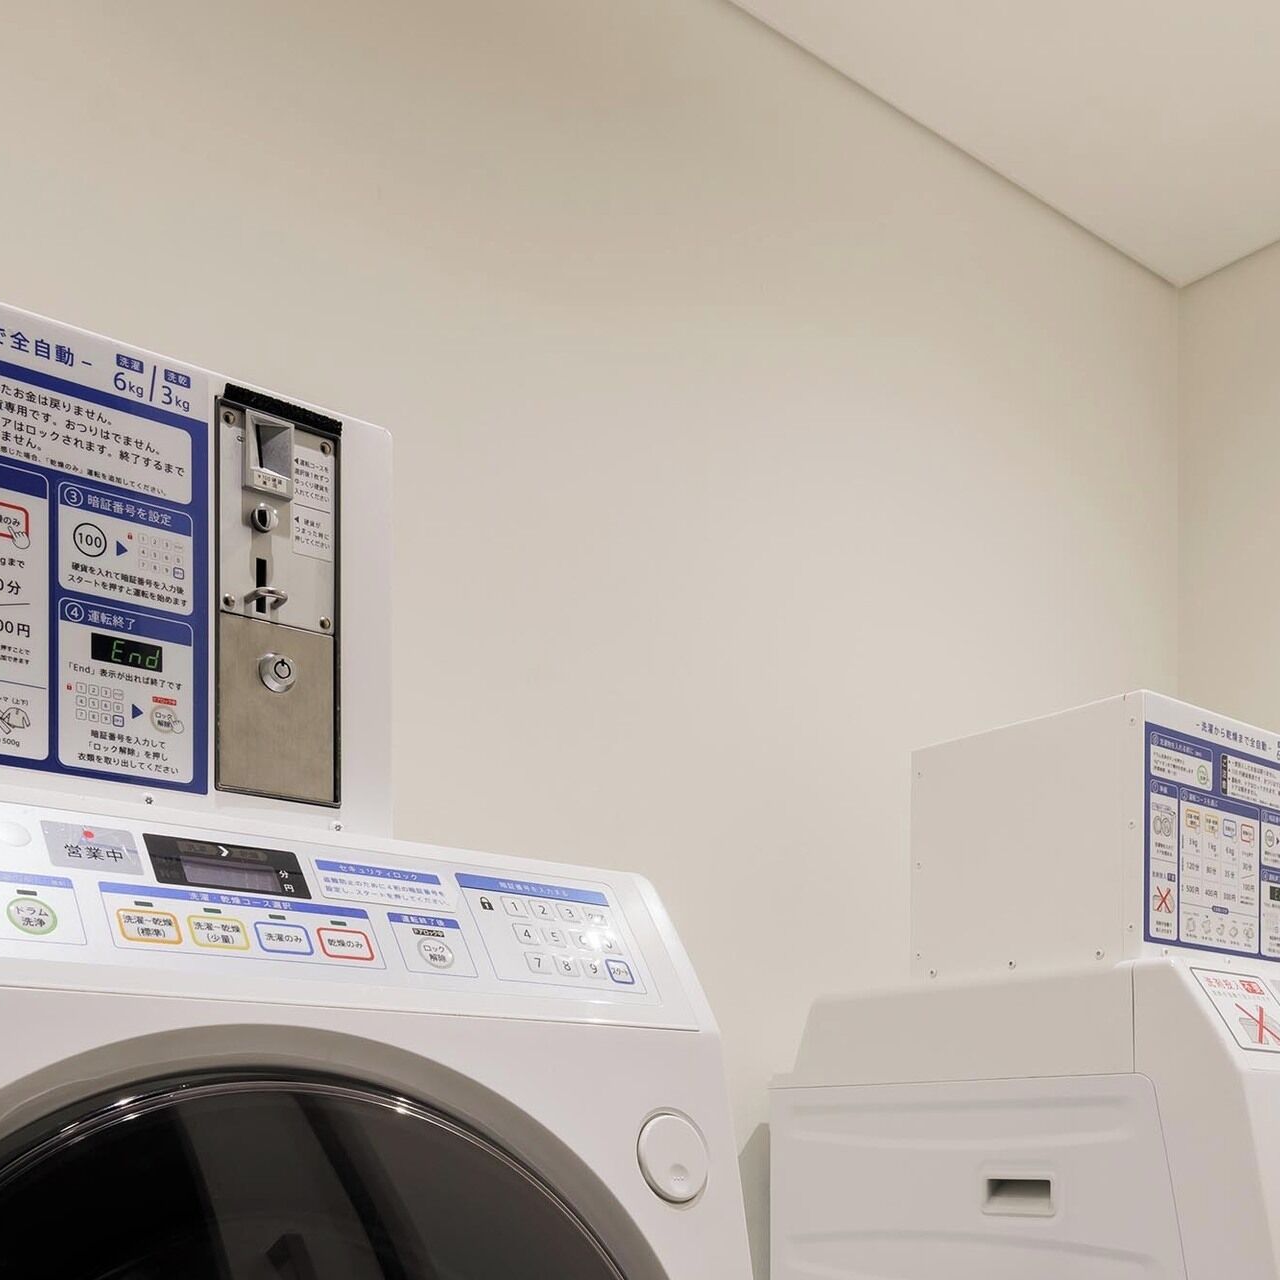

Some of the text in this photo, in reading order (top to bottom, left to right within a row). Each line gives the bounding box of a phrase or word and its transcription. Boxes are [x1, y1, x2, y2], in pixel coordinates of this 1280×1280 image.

[119, 357, 142, 372] 洗濯
[87, 494, 172, 527] 暗証番号を設定
[77, 531, 101, 549] 100
[71, 561, 185, 595] 硬貨を入れて暗証番号を入力後
[67, 574, 188, 608] スタートを押すと運転を始めます
[87, 609, 136, 631] 運転終了
[111, 639, 160, 670] End
[90, 729, 166, 749] 暗証番号を入力して
[77, 752, 179, 775] 衣類を取り出してください
[63, 843, 125, 864] 営業中
[15, 906, 49, 917] ドラム
[539, 905, 548, 915] 2
[566, 908, 575, 918] 3
[22, 917, 46, 928] 洗浄
[264, 932, 303, 944] 洗濯のみ
[327, 937, 363, 949] 乾燥のみ
[524, 929, 531, 939] 4
[551, 932, 559, 942] 5
[423, 944, 445, 953] ロック
[534, 957, 542, 968] 7
[563, 961, 572, 971] 8
[589, 963, 598, 974] 9
